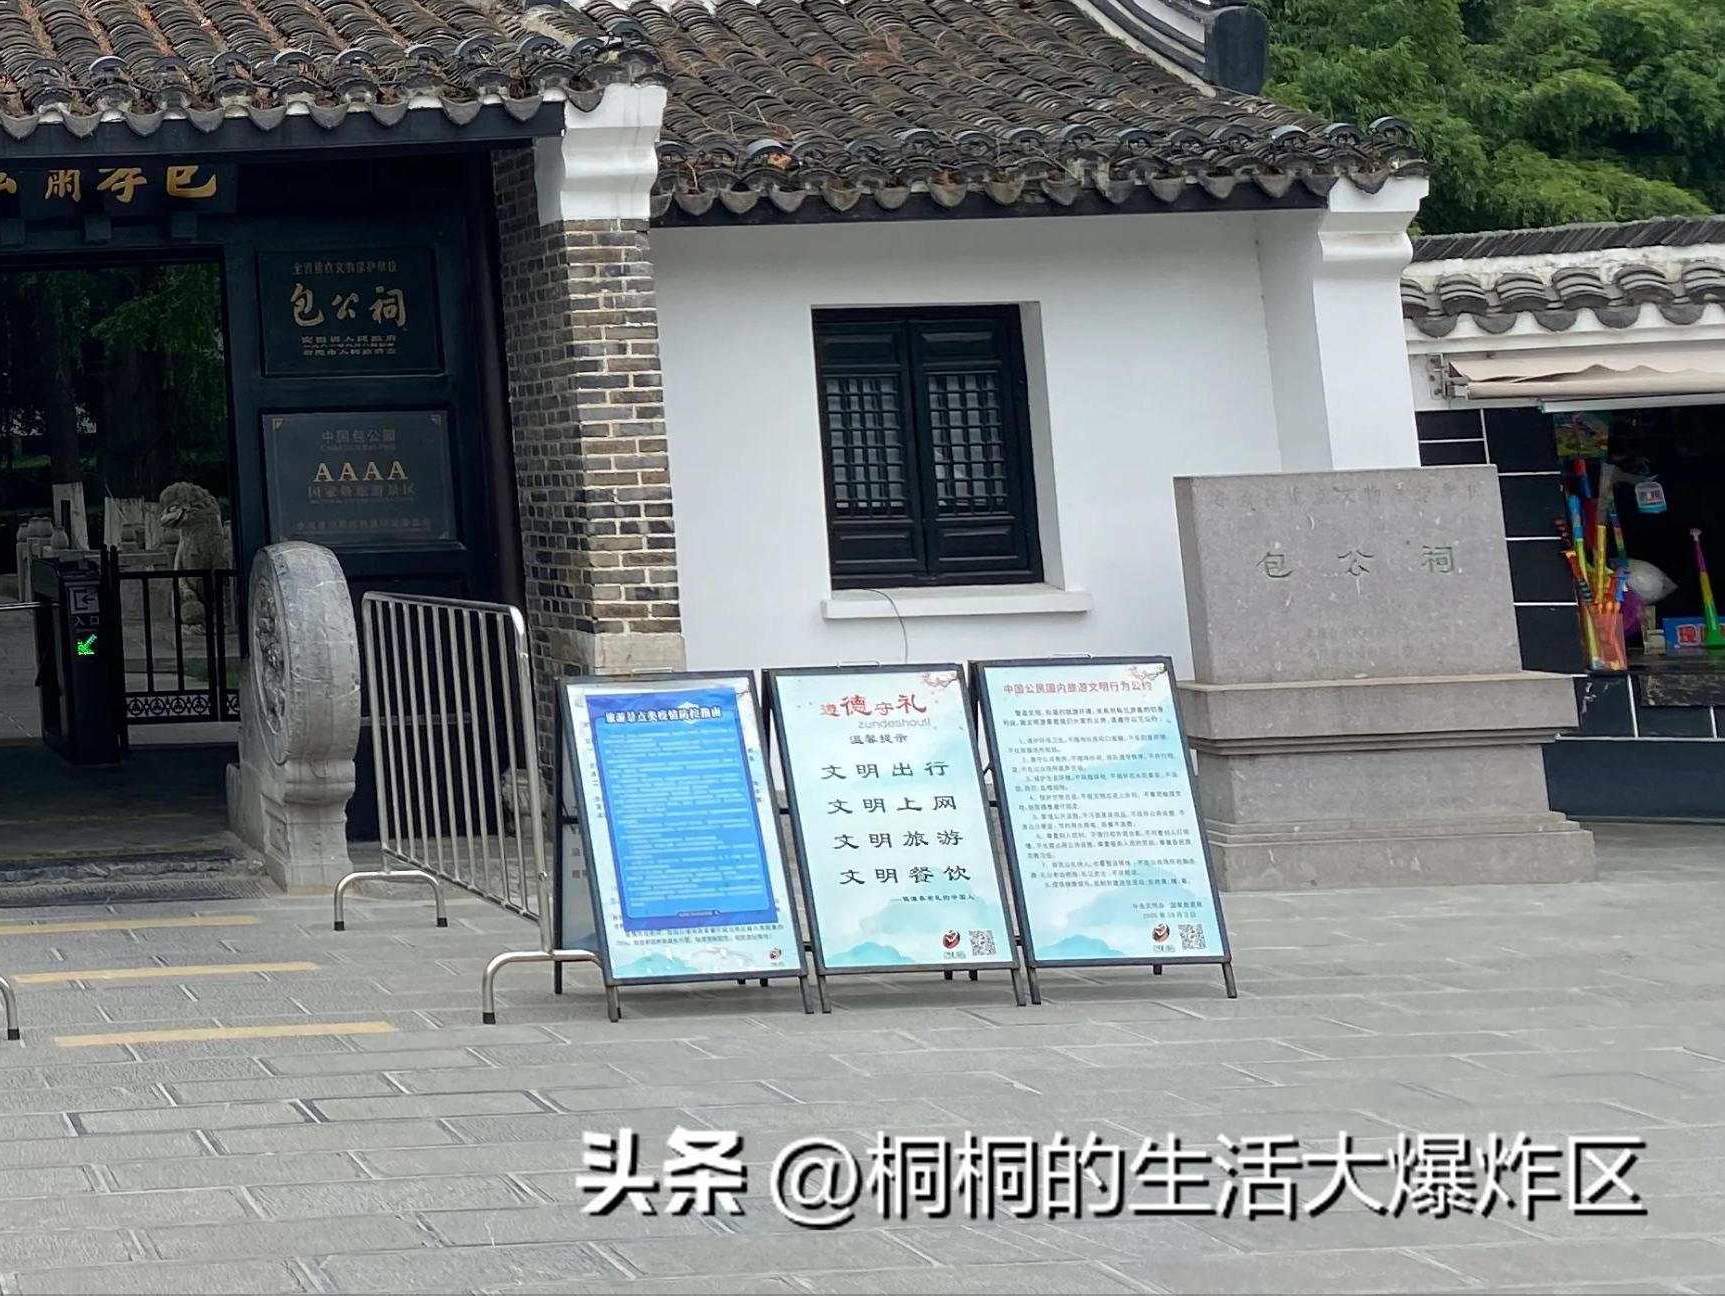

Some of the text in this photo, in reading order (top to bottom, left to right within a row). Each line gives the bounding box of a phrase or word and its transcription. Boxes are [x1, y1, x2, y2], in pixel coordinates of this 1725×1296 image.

[290, 282, 407, 327] 包公祠
[321, 429, 396, 444] 中国包公园
[1256, 544, 1456, 579] 包公祠
[74, 615, 100, 626] 入口
[1003, 680, 1153, 695] 中国公民国内旅游文明行为公约
[819, 694, 928, 717] 遵德守礼
[849, 733, 908, 745] 温馨提示
[820, 760, 950, 780] 文明出行
[827, 795, 957, 815] 文明上网
[833, 829, 964, 850] 文明旅游
[839, 864, 971, 885] 文明餐饮
